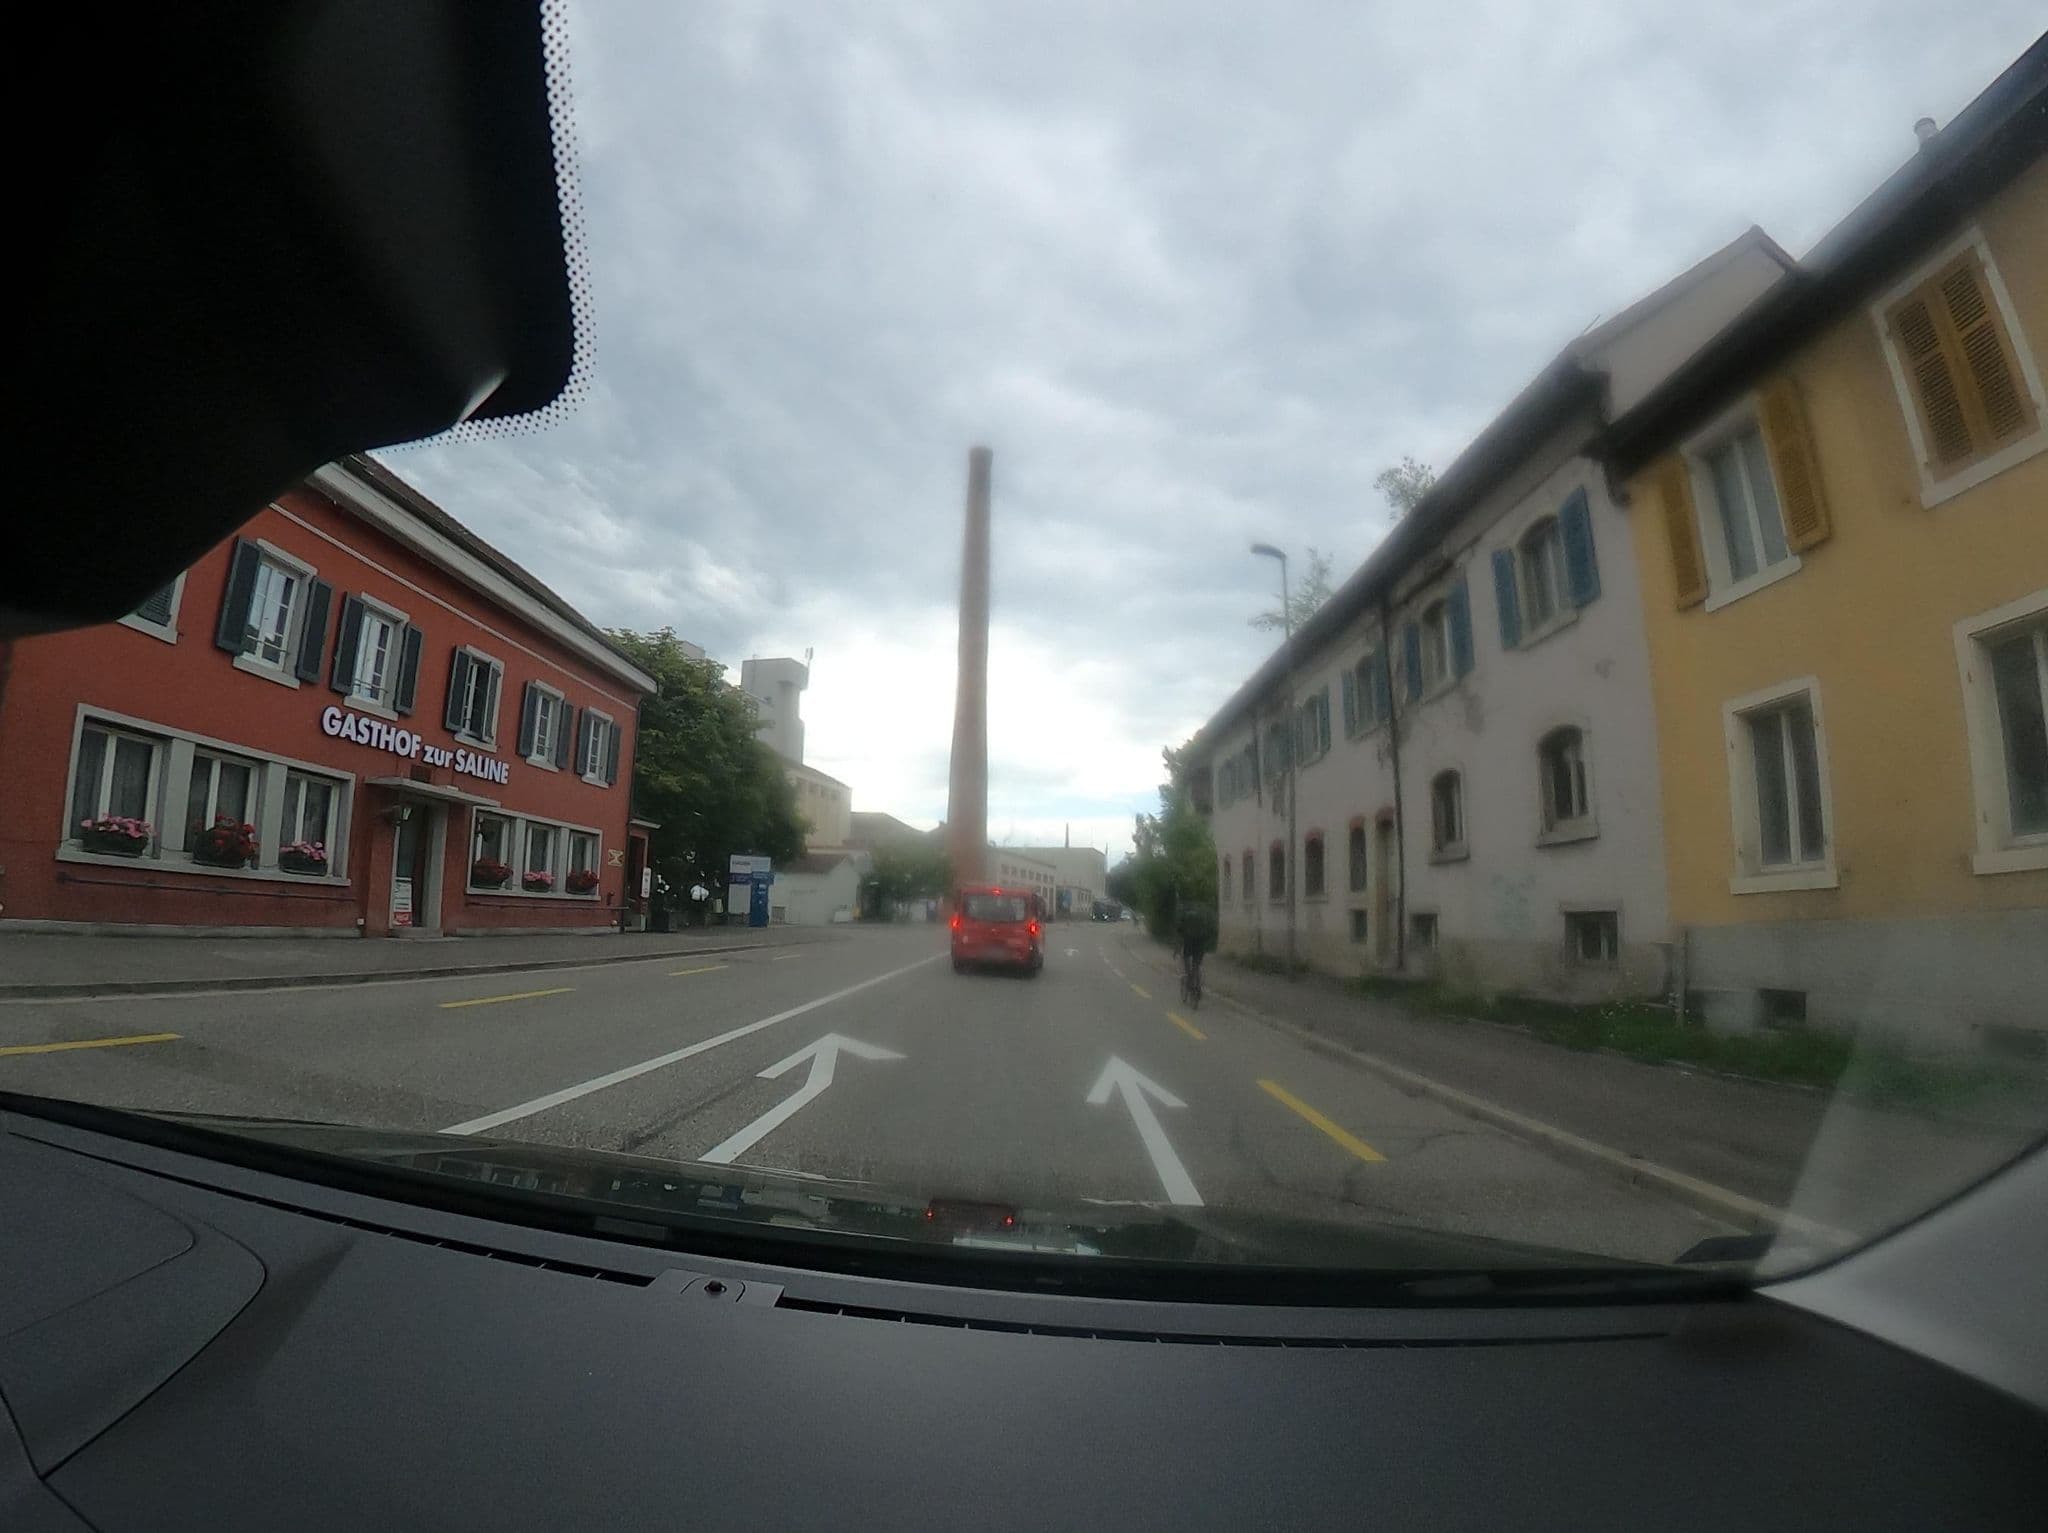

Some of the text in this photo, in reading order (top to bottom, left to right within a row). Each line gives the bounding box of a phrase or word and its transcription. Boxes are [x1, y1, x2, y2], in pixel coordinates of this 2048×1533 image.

[322, 706, 510, 784] GASTHOF zur SALINE
